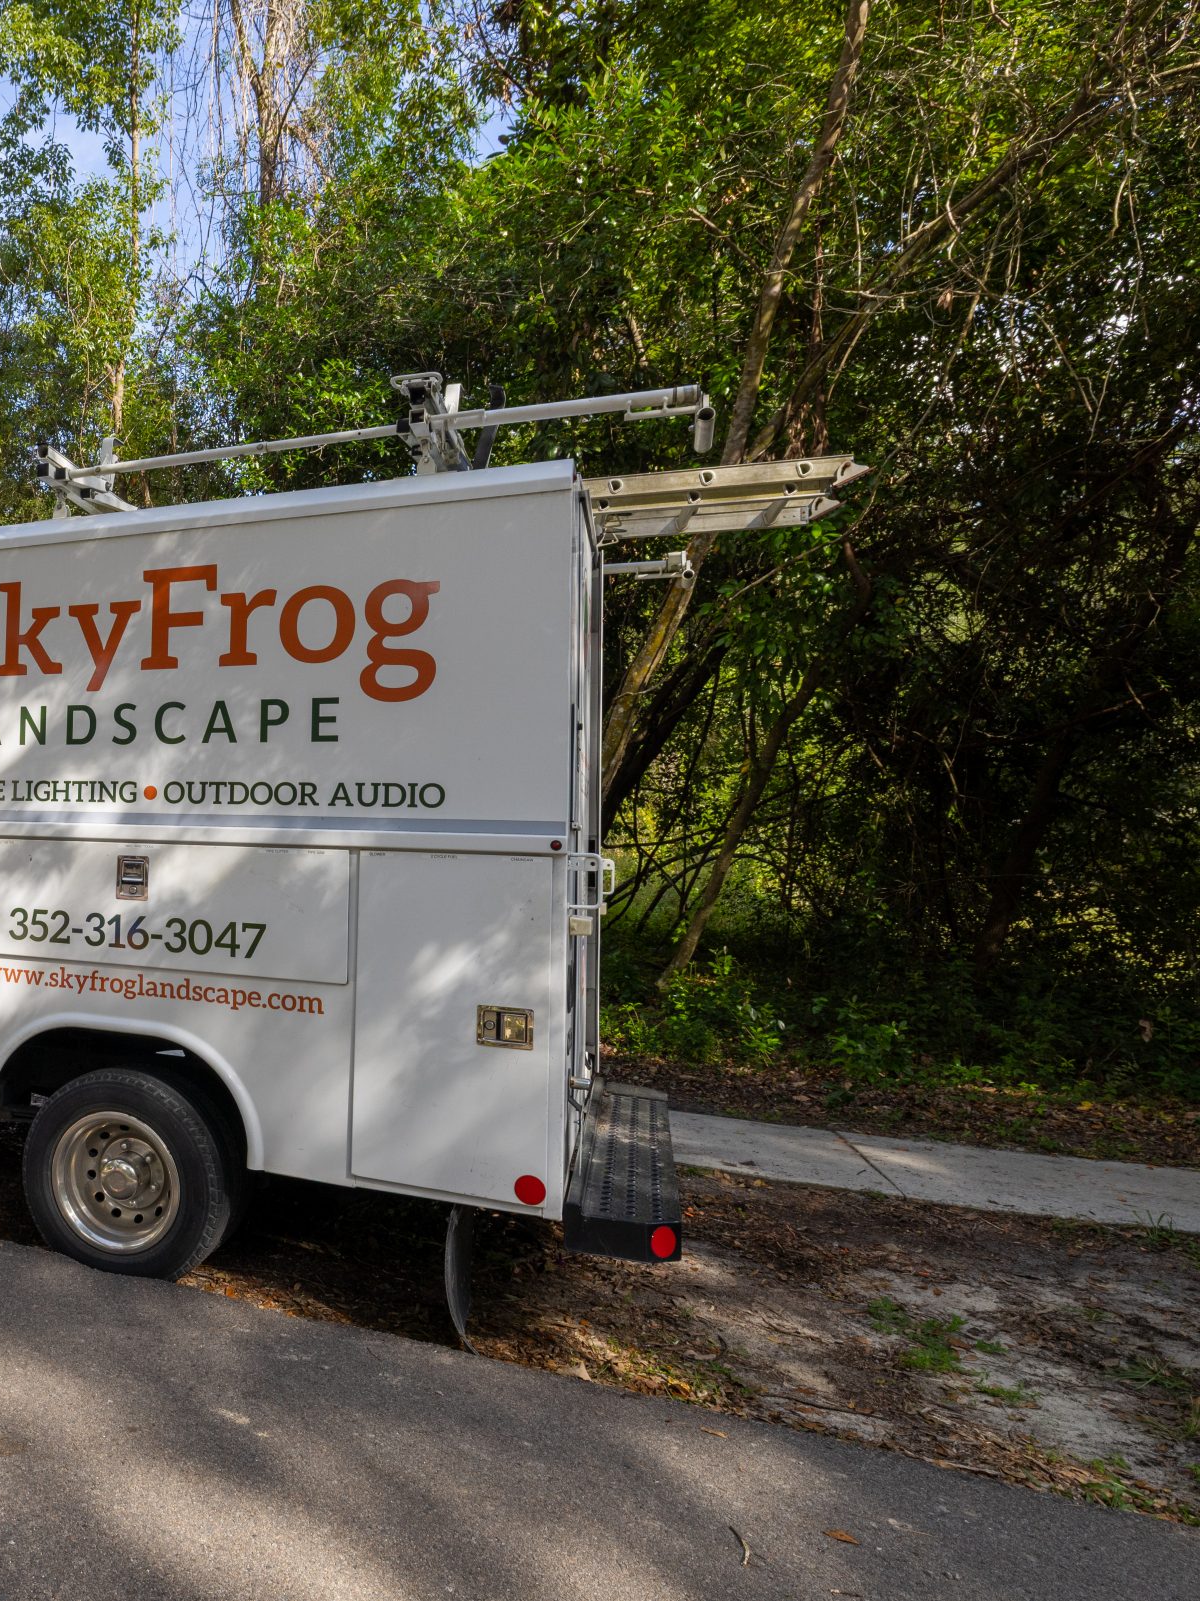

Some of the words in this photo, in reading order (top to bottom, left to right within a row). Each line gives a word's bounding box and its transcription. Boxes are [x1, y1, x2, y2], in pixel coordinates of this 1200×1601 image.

[11, 780, 137, 804] LIGHTING
[163, 781, 320, 807] OUTDOOR
[327, 782, 446, 809] AUDIO
[8, 907, 267, 960] 352-316-3047
